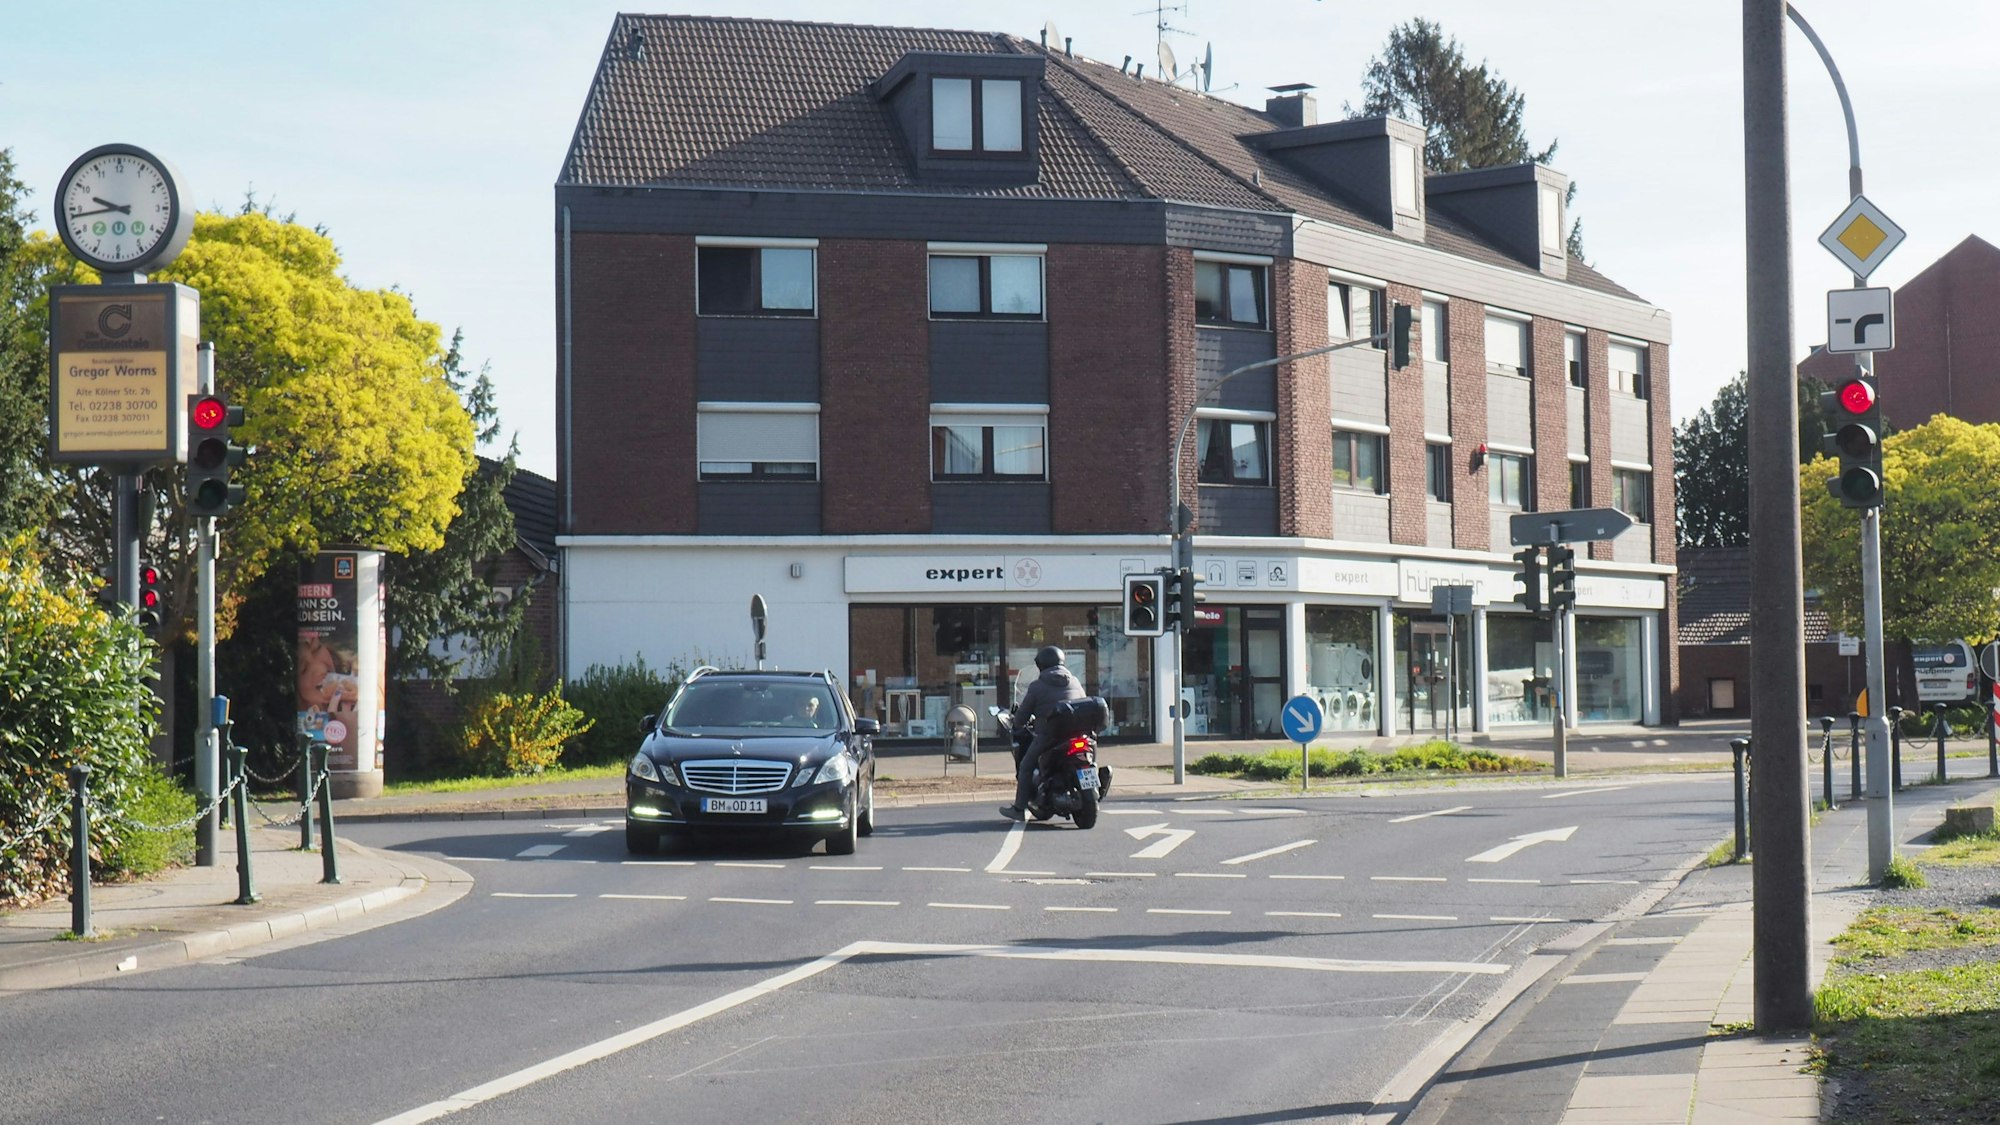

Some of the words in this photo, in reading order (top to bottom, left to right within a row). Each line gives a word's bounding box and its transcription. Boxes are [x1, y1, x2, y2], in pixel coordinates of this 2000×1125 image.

[78, 338, 149, 349] Continentale
[69, 366, 109, 380] Gregor
[115, 365, 157, 376] Worms
[76, 388, 92, 397] Alte
[95, 388, 120, 396] Kölner
[124, 387, 137, 395] Str.
[140, 387, 151, 395] 2b
[69, 402, 86, 411] Tel.
[89, 401, 122, 411] 02238
[126, 400, 158, 410] 30700
[122, 414, 150, 422] 307011
[926, 567, 1003, 582] expert
[1335, 572, 1368, 584] expert
[320, 598, 338, 609] SO
[313, 610, 346, 622] SEIN.
[711, 800, 725, 811] BM
